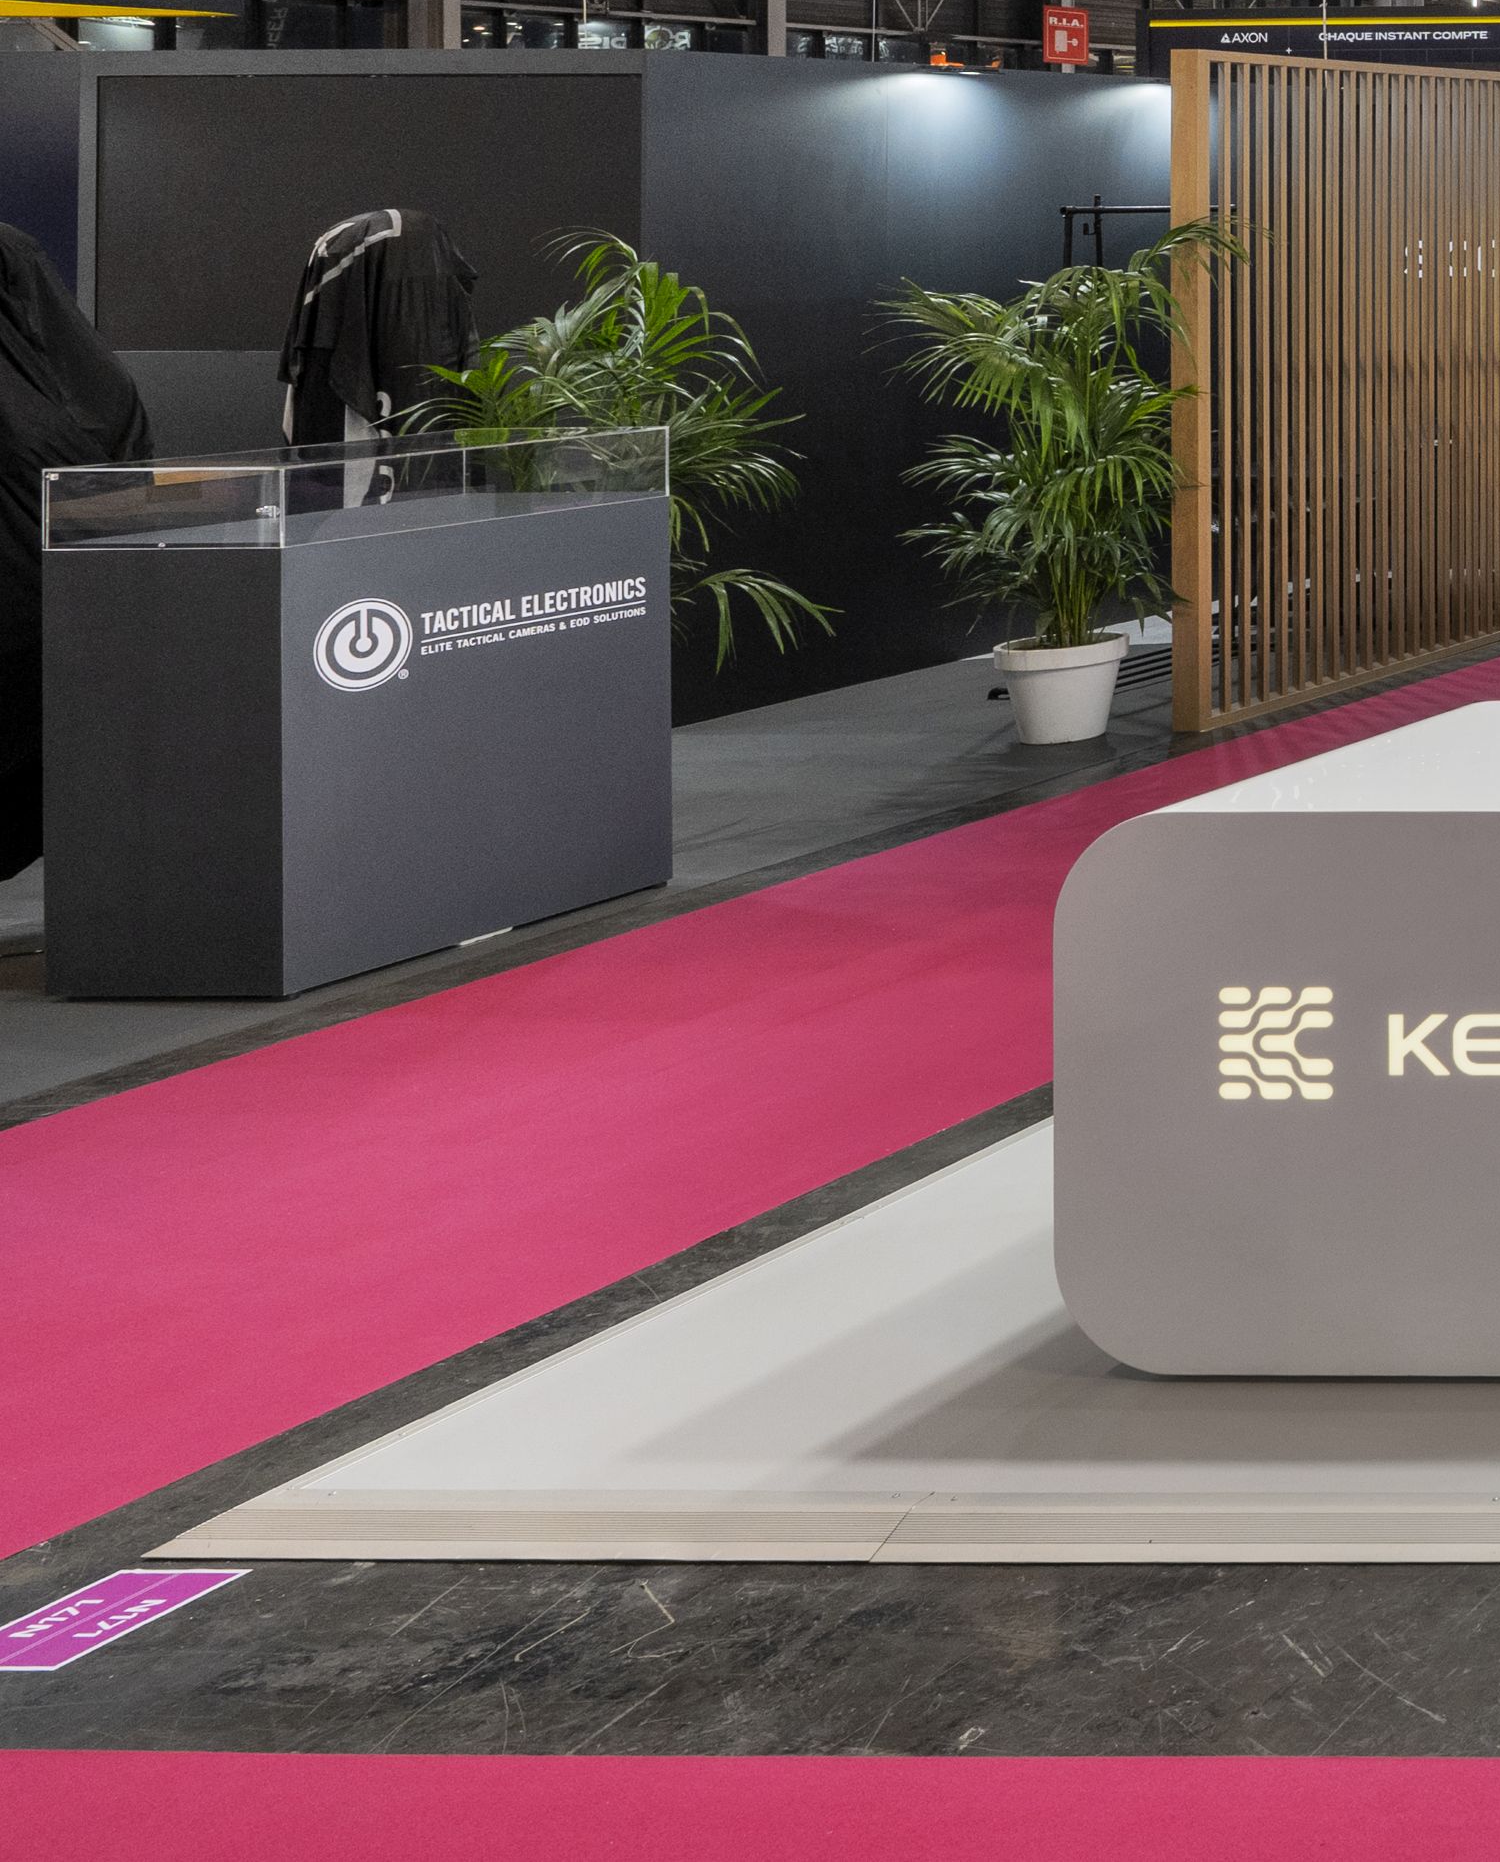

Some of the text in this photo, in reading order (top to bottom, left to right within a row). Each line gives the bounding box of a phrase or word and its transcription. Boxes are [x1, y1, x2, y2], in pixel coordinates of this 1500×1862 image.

[1049, 17, 1084, 28] R.I.A.
[1232, 32, 1268, 43] AXON
[1319, 30, 1488, 42] CHAQUE INSTANT COMPTE
[421, 576, 647, 635] TACTICAL ELECTRONICS
[421, 606, 647, 656] ELITE TACTICAL CAMERAS & EOD SOLUTIONS
[8, 1599, 104, 1637] N171
[72, 1599, 167, 1637] N171
